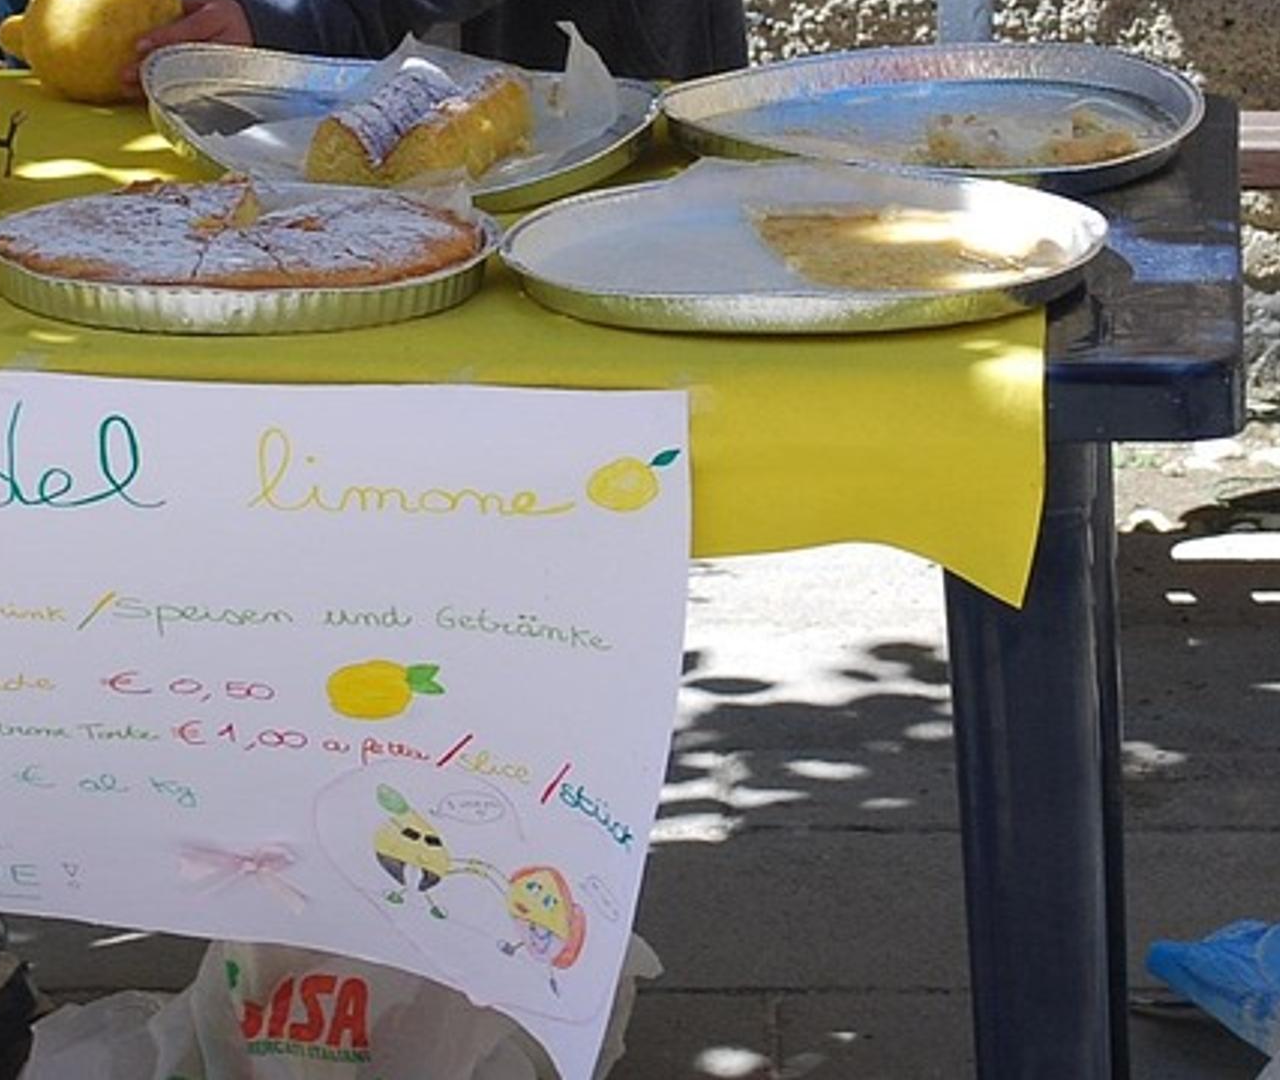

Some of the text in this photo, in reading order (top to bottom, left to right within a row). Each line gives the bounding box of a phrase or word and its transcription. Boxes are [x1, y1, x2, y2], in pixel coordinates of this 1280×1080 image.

[248, 427, 577, 517] limone
[320, 601, 413, 628] und
[79, 772, 131, 793] al
